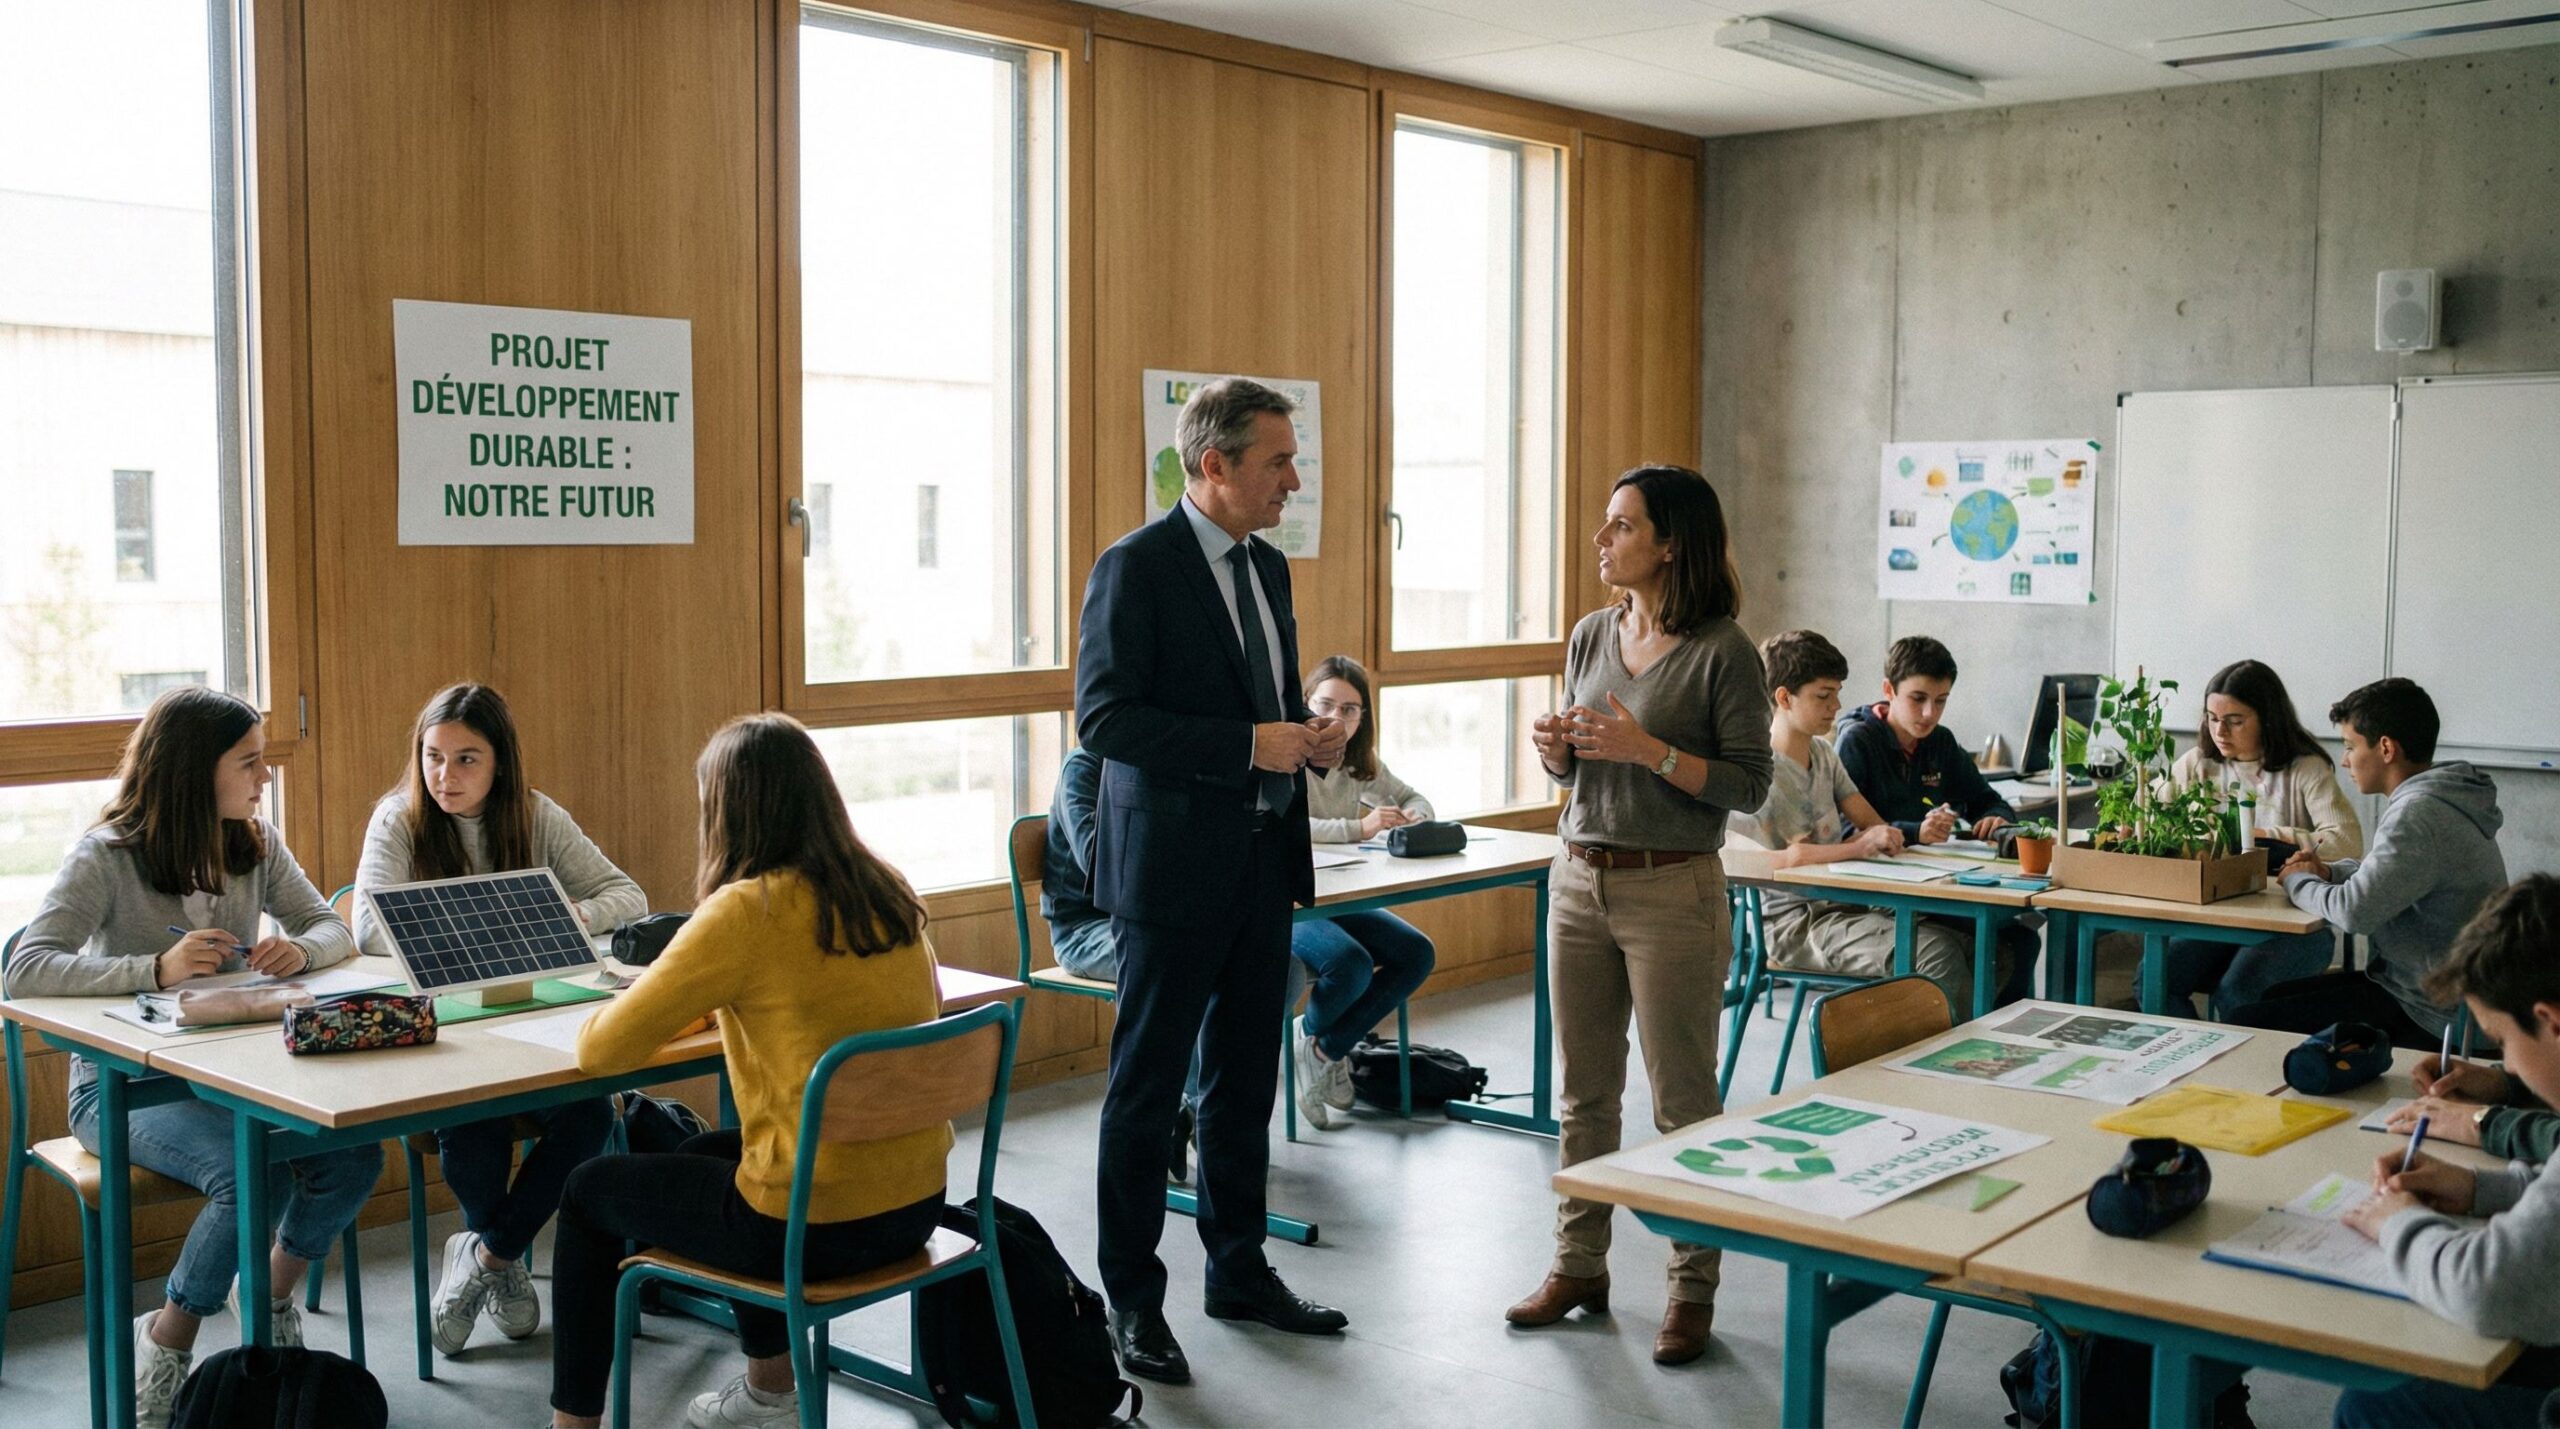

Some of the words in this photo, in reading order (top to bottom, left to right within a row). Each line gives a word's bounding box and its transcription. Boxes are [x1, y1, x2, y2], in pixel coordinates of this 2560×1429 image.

[490, 332, 610, 372] PROJET
[411, 372, 680, 423] DÉVELOPPEMENT
[469, 433, 614, 470] DURABLE
[444, 483, 549, 518] NOTRE
[559, 485, 655, 518] FUTUR
